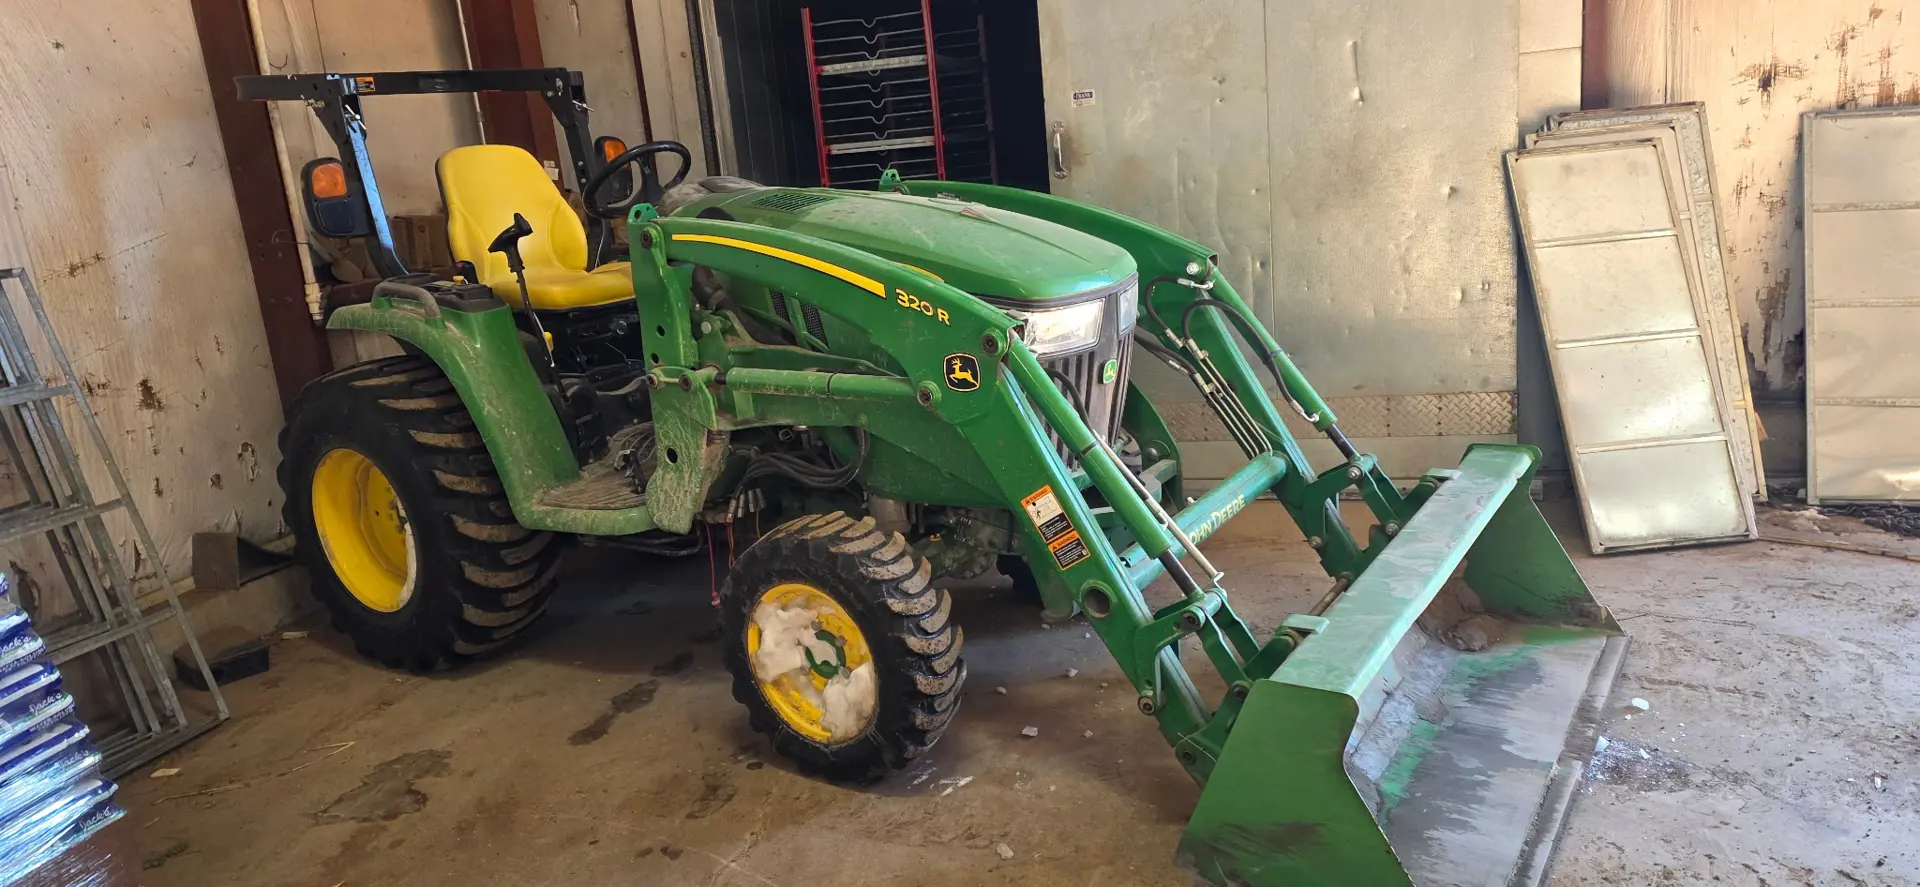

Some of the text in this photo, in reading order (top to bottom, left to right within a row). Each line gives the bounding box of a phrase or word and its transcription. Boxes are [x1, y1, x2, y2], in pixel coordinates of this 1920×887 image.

[895, 288, 951, 326] 320 R
[1189, 493, 1246, 546] OHN DEERE
[28, 692, 63, 717] Jack's
[78, 806, 112, 831] Jack's
